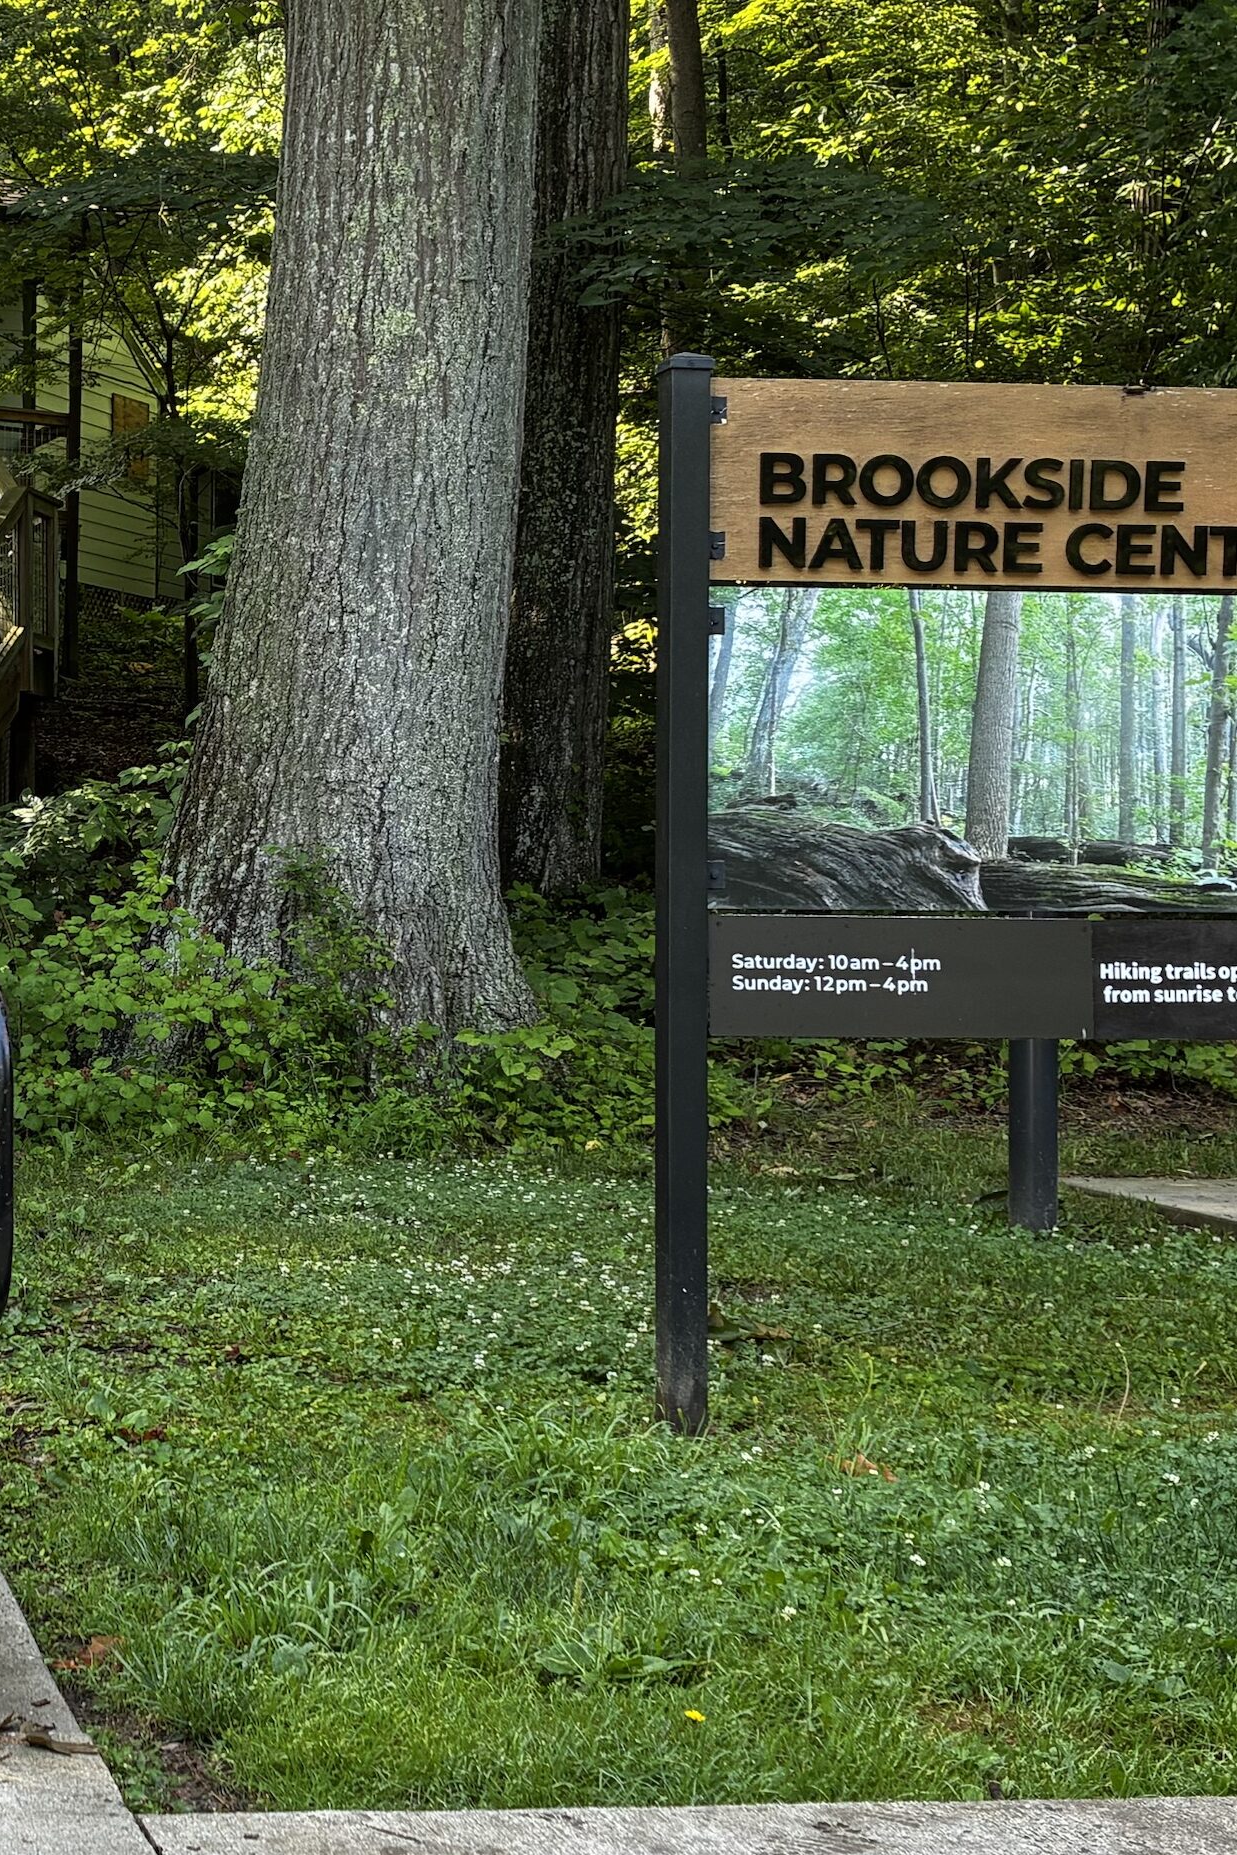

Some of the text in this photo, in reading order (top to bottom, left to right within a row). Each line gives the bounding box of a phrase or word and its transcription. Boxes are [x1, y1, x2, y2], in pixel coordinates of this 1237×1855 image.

[759, 452, 1185, 512] BROOKSIDE
[758, 516, 1237, 576] NATURE CENT
[732, 953, 824, 973] Saturday:
[1099, 961, 1163, 984] Hiking
[1164, 961, 1216, 980] trails
[732, 975, 810, 994] Sunday:
[1103, 984, 1237, 1003] from sunrise t
